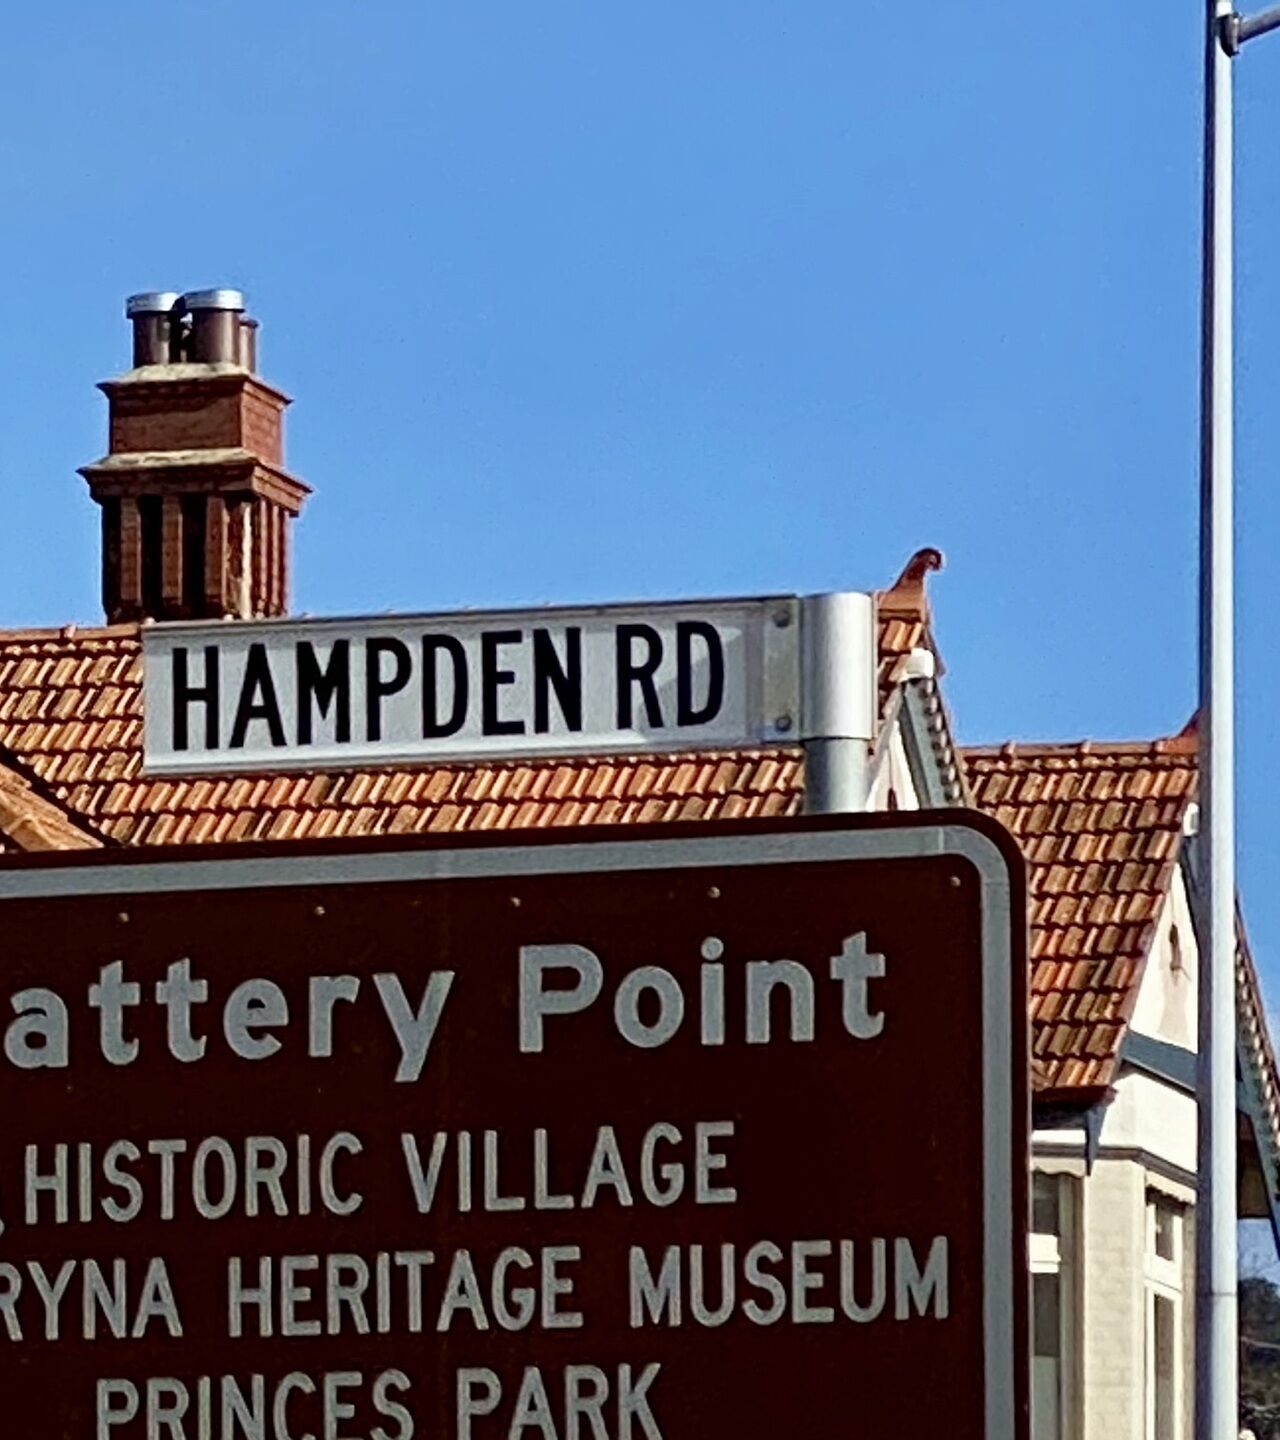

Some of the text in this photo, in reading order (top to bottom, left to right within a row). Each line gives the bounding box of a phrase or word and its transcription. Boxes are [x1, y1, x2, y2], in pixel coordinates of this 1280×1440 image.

[172, 620, 725, 752] HAMPDEN RD
[519, 931, 886, 1053] Point
[25, 1121, 737, 1224] HISTORIC VILLAGE
[227, 1245, 583, 1339] HERITAGE
[630, 1235, 949, 1329] MUSEUM
